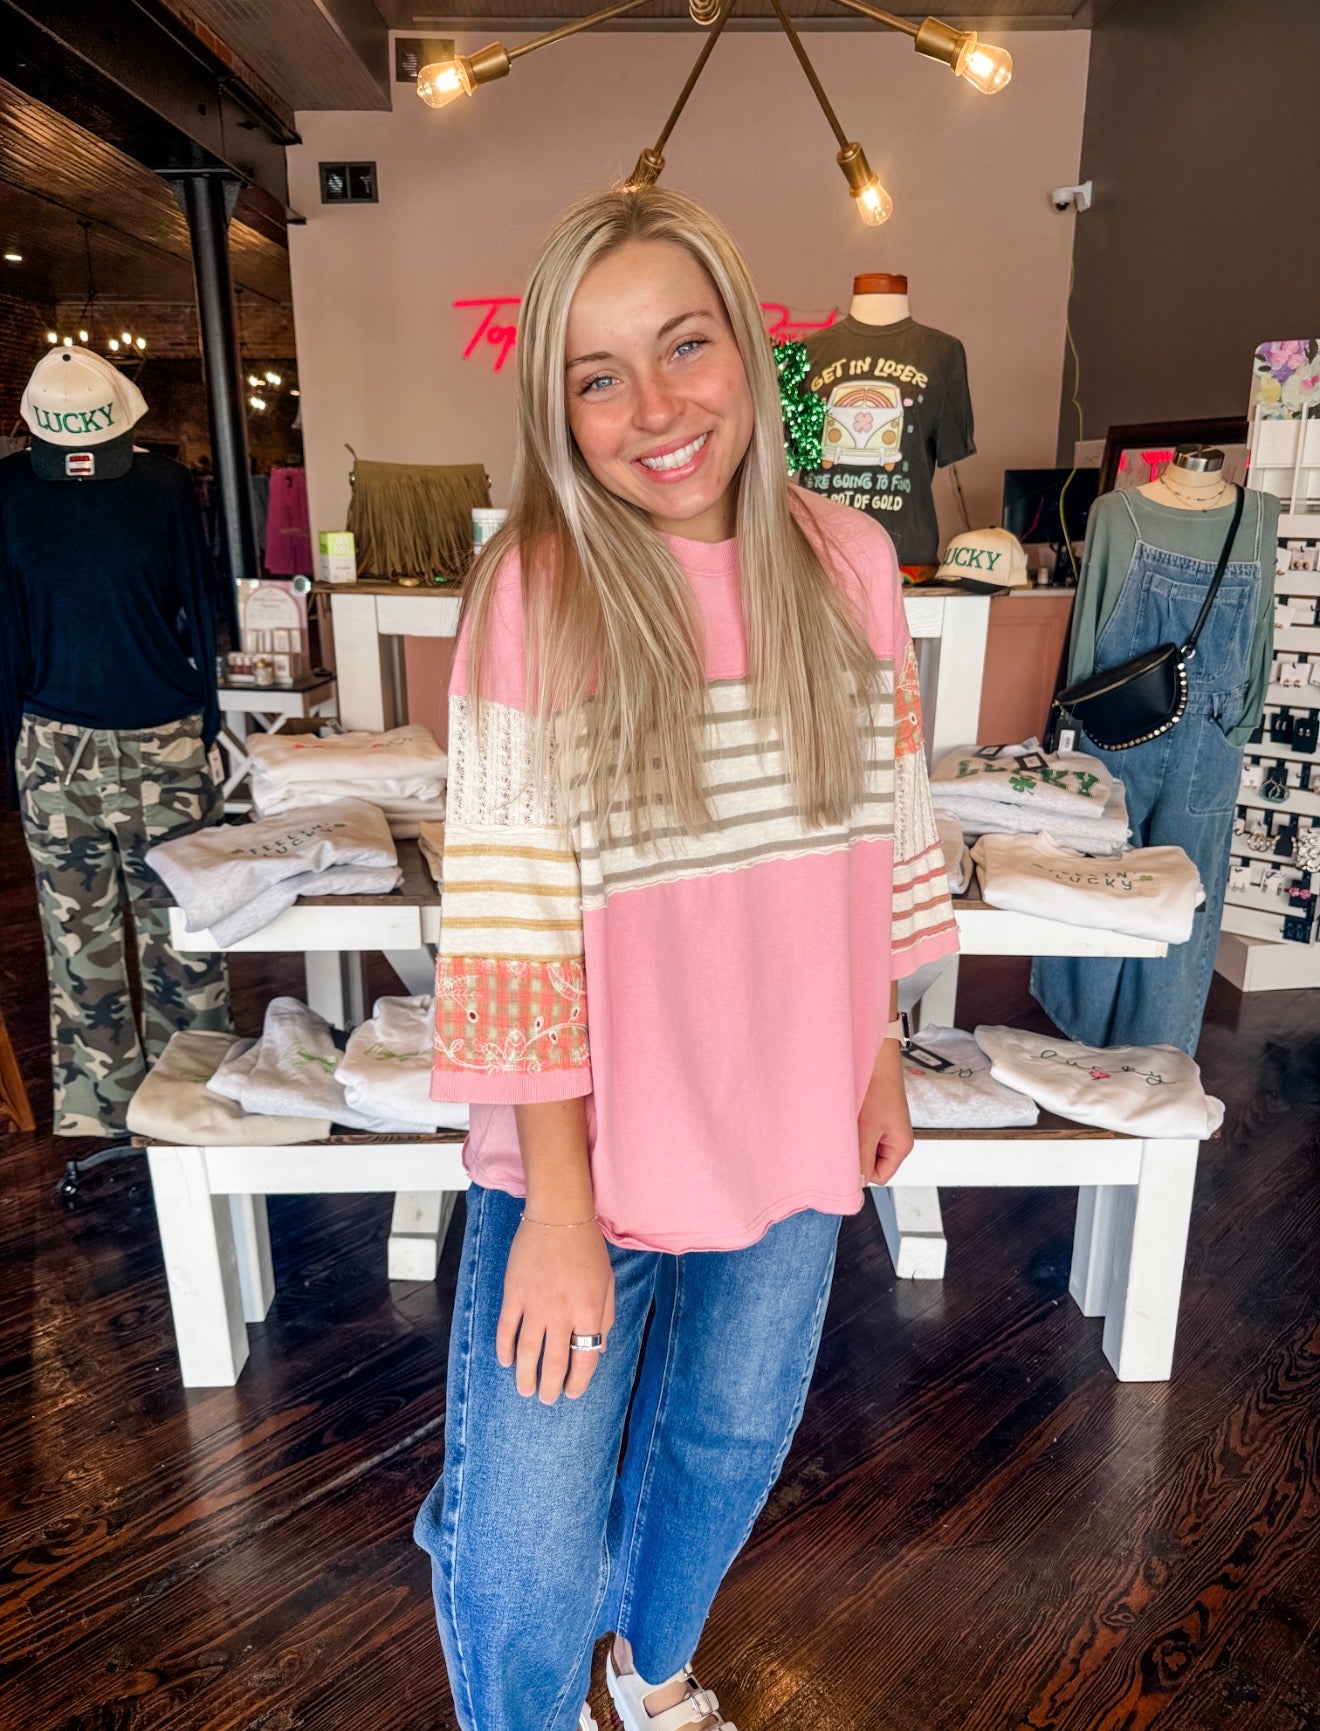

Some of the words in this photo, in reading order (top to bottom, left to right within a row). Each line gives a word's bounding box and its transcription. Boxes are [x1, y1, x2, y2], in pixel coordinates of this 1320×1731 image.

[810, 358, 847, 392] GET
[849, 356, 872, 376] IN
[873, 358, 929, 389] LOSER
[33, 402, 115, 434] LUCKY
[832, 472, 873, 490] GOING
[876, 474, 889, 491] TO
[891, 474, 911, 494] FIND
[854, 493, 871, 510] OF
[871, 494, 903, 512] GOLD
[956, 760, 1099, 798] LKY
